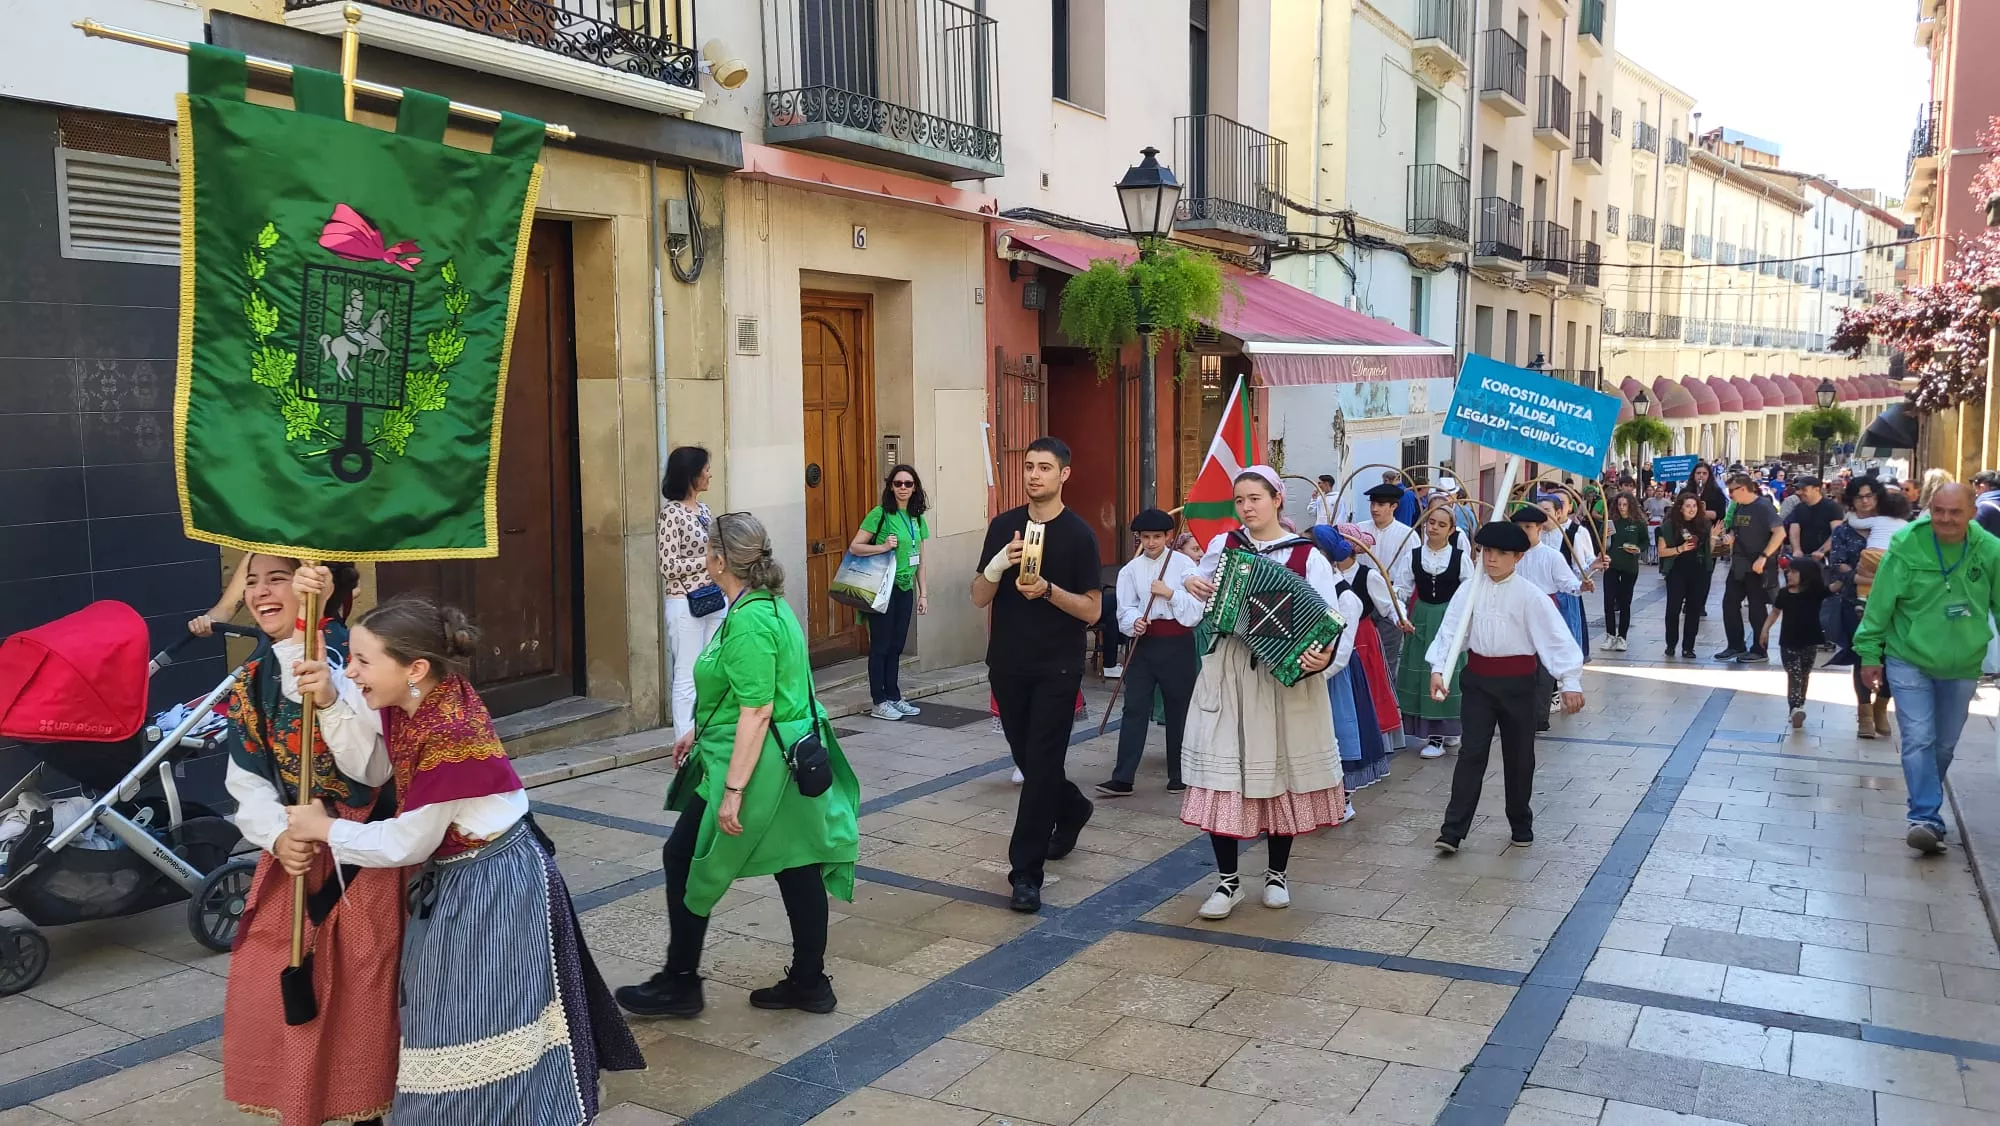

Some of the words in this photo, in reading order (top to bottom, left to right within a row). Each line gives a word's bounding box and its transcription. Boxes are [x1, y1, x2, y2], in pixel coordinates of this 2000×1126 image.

[856, 227, 865, 248] 6
[325, 384, 384, 399] HUESCA
[1481, 377, 1539, 405] KOROSTI
[1540, 397, 1593, 422] DANTZA
[1508, 402, 1556, 427] TALDEA
[1456, 405, 1510, 431] LEGAZPI
[1520, 426, 1595, 457] GUIPÚZCOA
